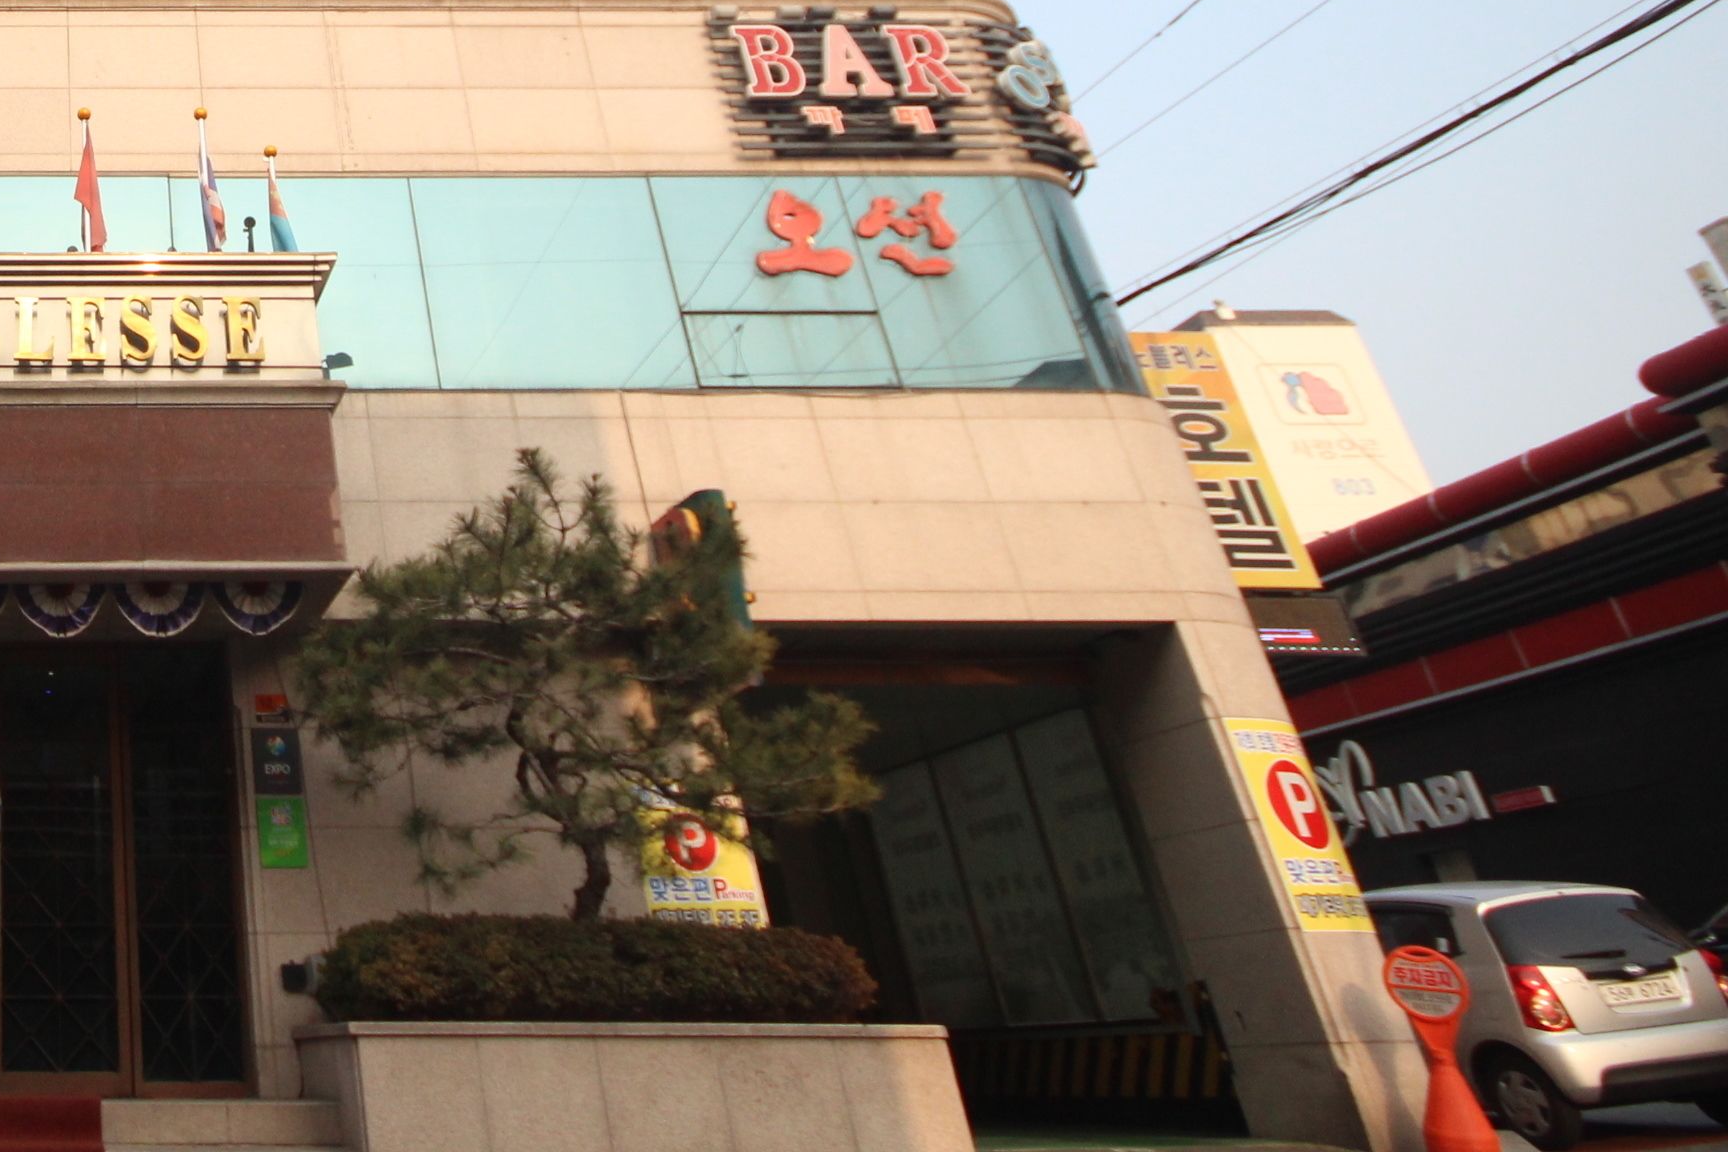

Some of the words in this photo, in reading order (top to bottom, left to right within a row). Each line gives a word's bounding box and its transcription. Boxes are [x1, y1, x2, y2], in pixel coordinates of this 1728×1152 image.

[729, 23, 972, 98] BAR
[1160, 386, 1296, 570] 호텔
[264, 762, 291, 776] EXPO
[1275, 771, 1318, 838] P
[1360, 770, 1490, 837] NABI
[648, 876, 712, 902] 맞은편
